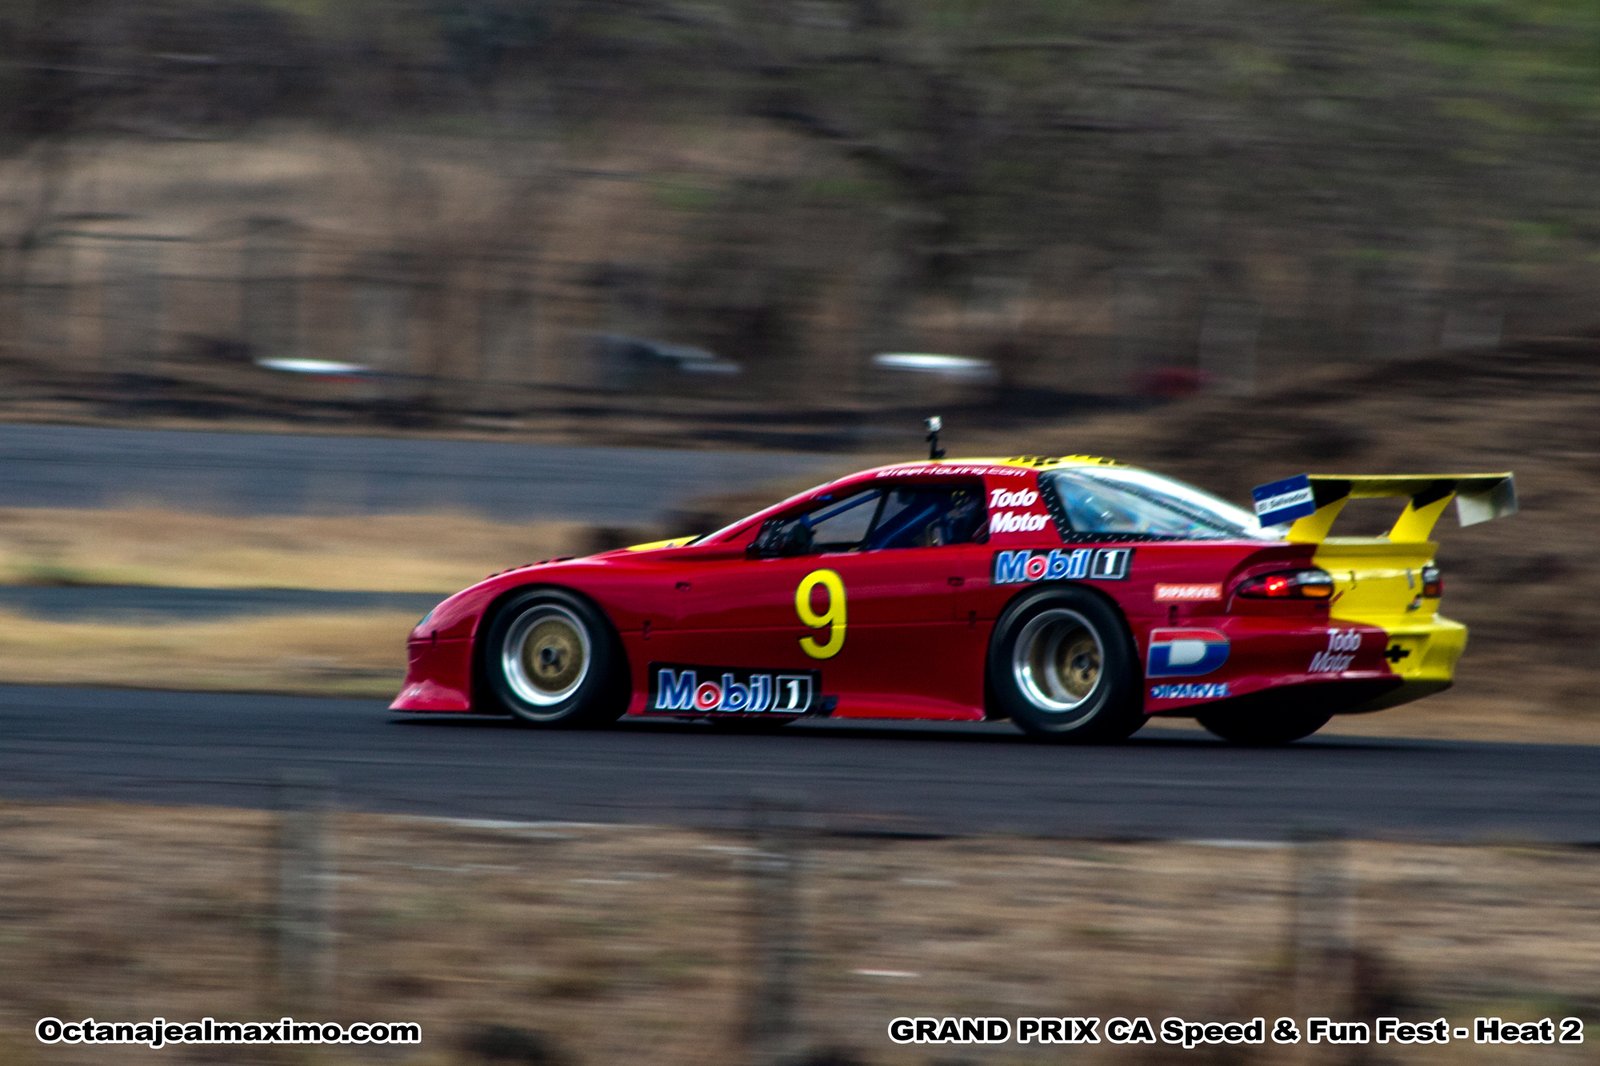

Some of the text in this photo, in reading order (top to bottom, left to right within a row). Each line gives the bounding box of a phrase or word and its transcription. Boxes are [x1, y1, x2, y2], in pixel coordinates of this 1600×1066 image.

[989, 488, 1039, 508] Todo
[989, 511, 1052, 534] Motor
[994, 550, 1089, 584] Mobil
[795, 569, 847, 659] 9
[1327, 628, 1361, 651] Todo
[1308, 651, 1356, 672] Motor
[655, 668, 771, 712] Mobil
